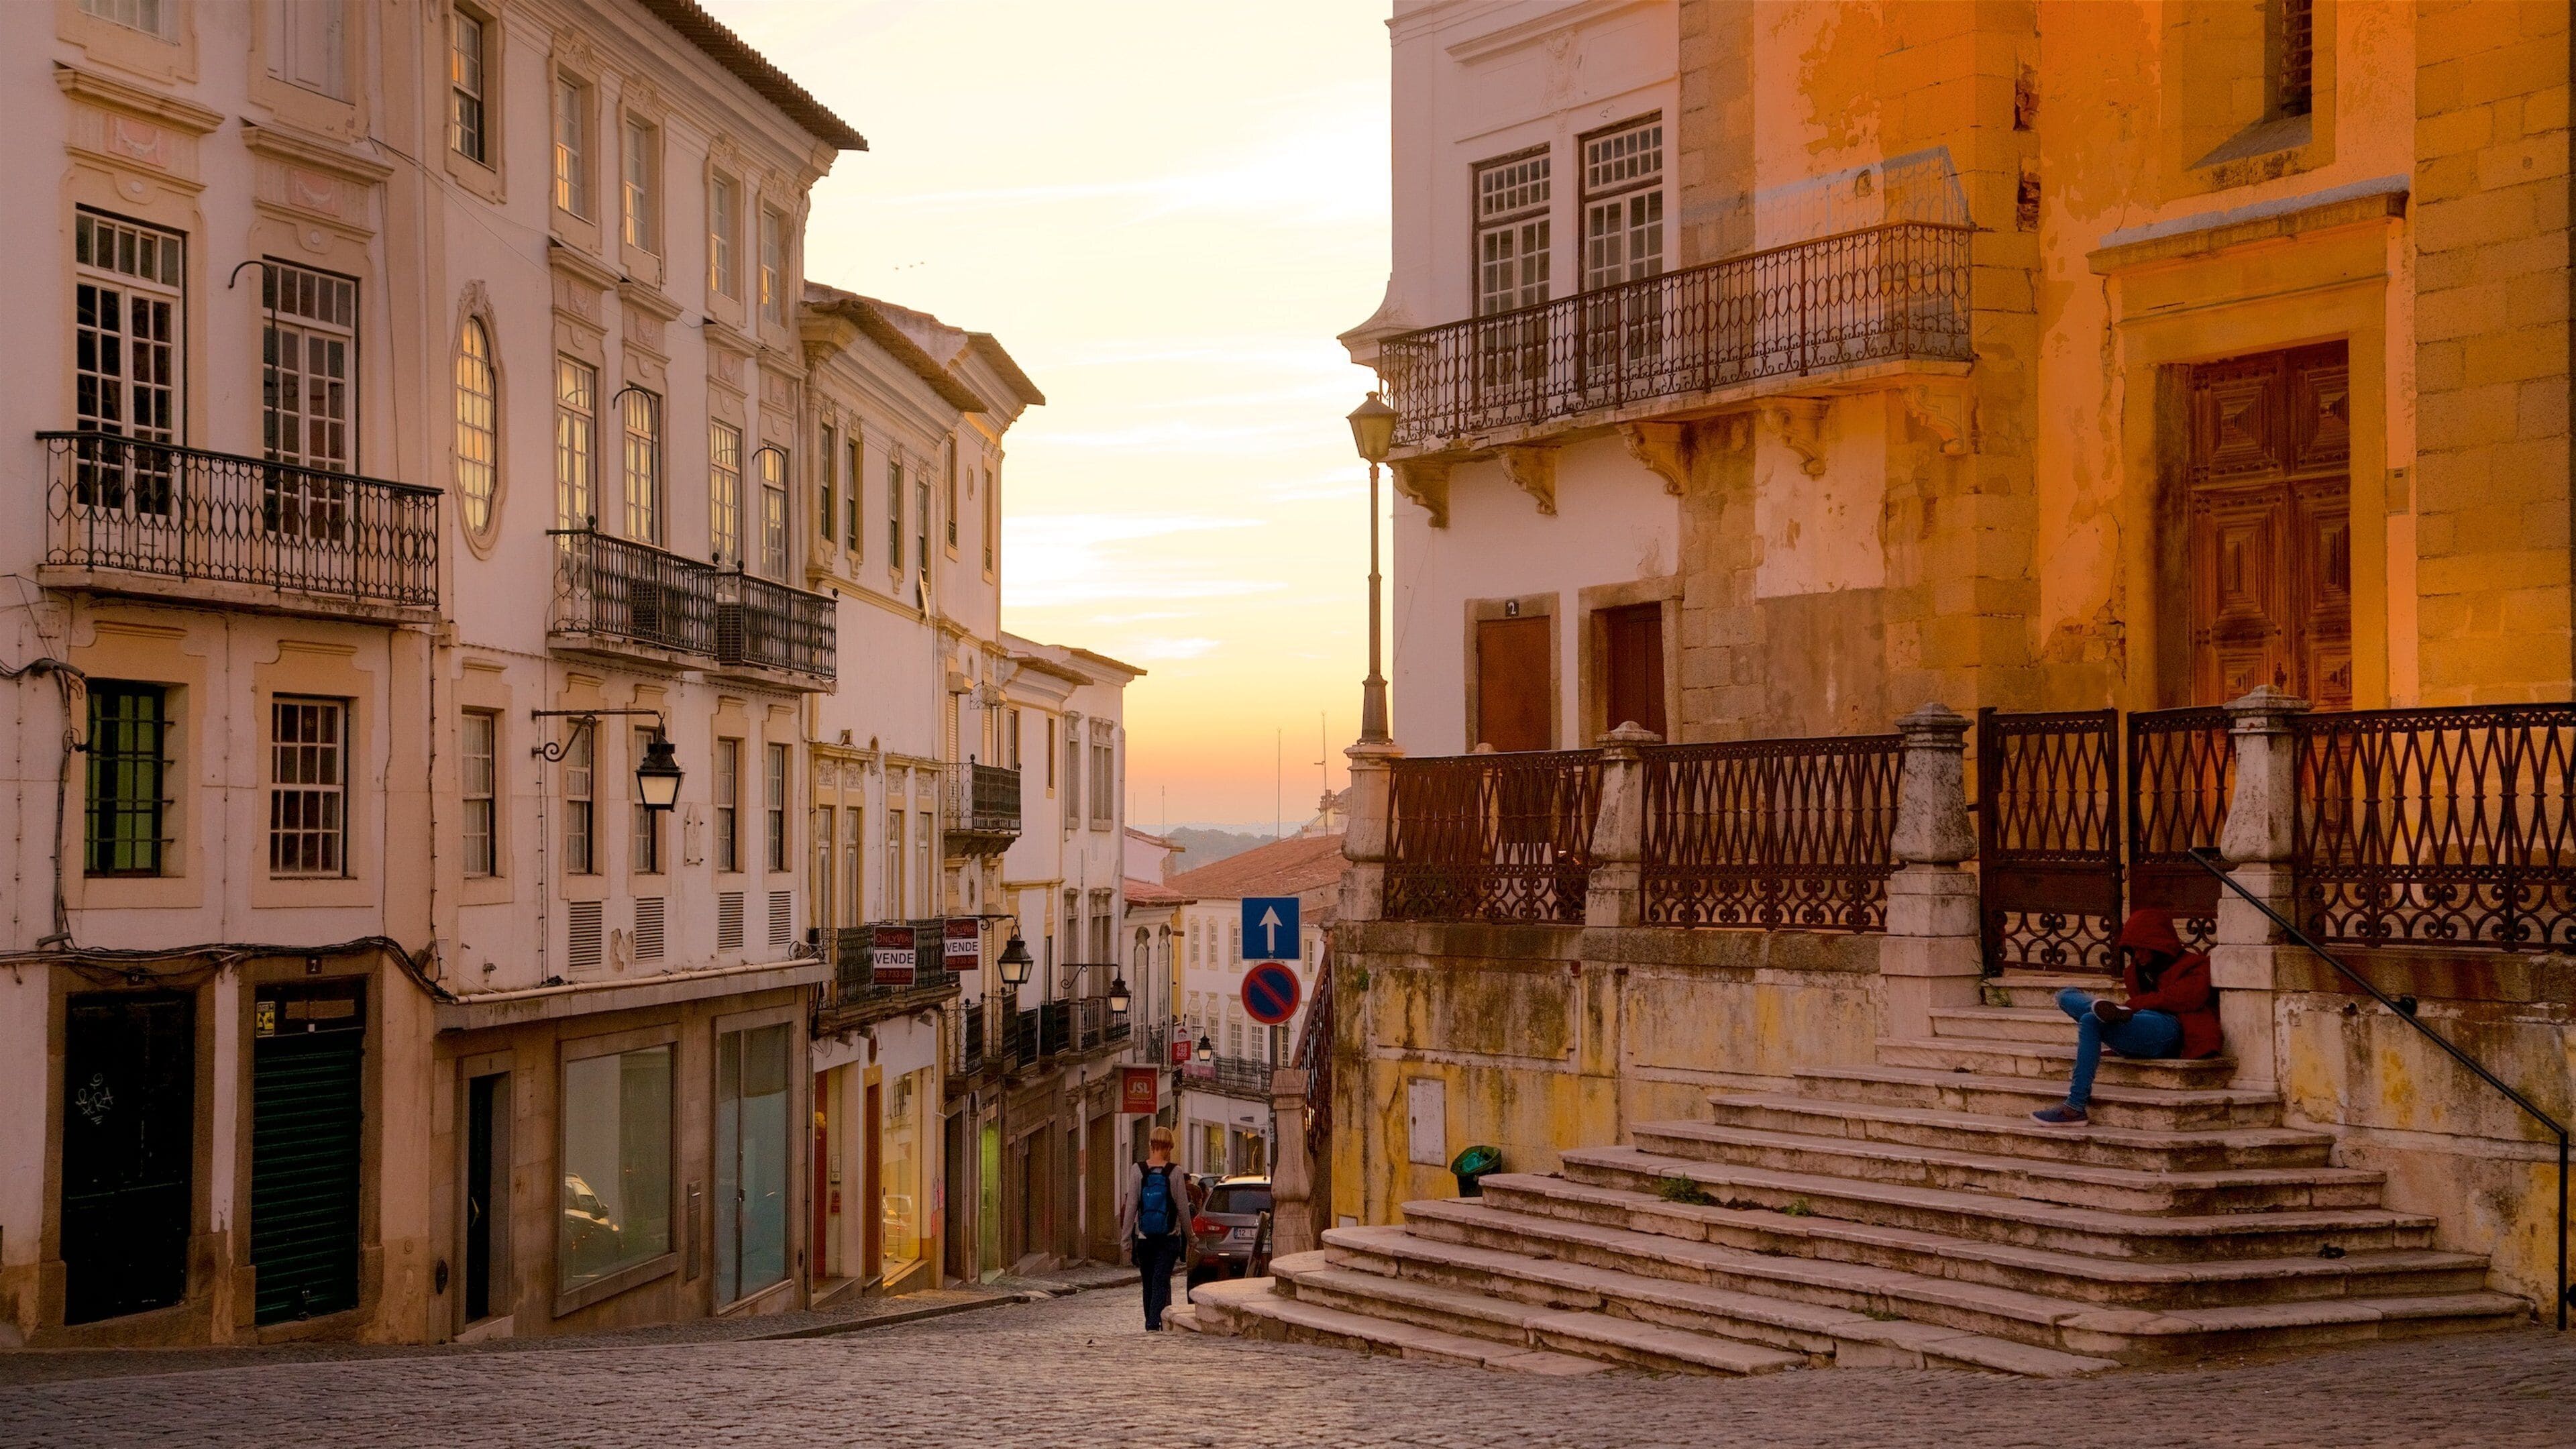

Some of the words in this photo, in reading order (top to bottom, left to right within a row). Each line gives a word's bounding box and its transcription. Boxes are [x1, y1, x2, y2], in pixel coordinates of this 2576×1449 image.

[1508, 602, 1516, 614] 2
[946, 941, 978, 952] VENDE
[875, 953, 914, 964] VENDE
[888, 970, 900, 978] 733
[901, 970, 912, 978] 240
[1130, 1081, 1150, 1094] JSL
